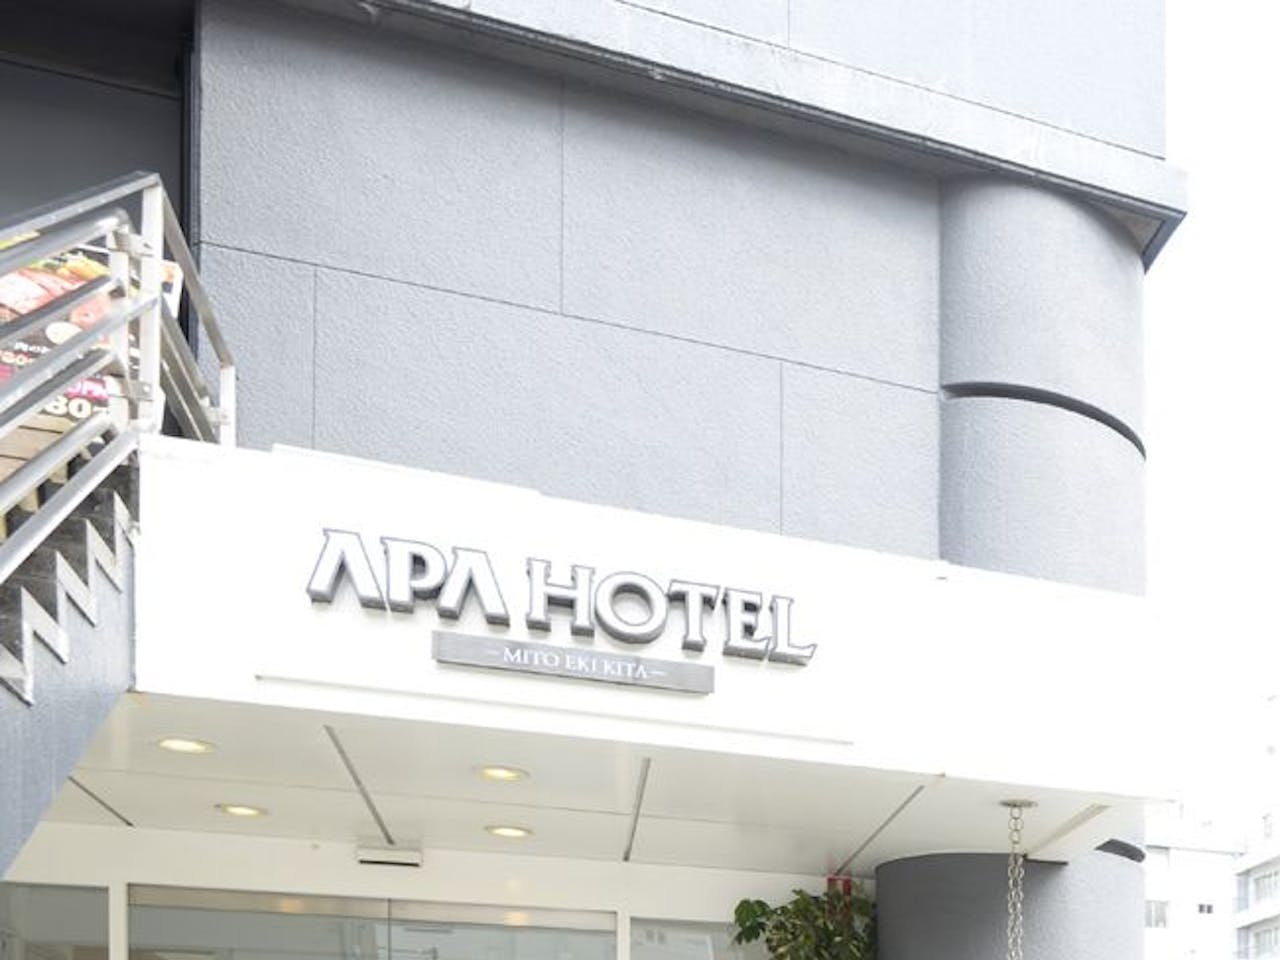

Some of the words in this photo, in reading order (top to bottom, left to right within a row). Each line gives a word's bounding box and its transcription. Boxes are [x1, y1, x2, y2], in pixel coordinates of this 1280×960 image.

[306, 528, 510, 626] APA
[526, 557, 816, 665] HOTEL
[503, 647, 559, 667] MITO
[565, 654, 597, 673] EKI
[603, 660, 648, 679] KITA
